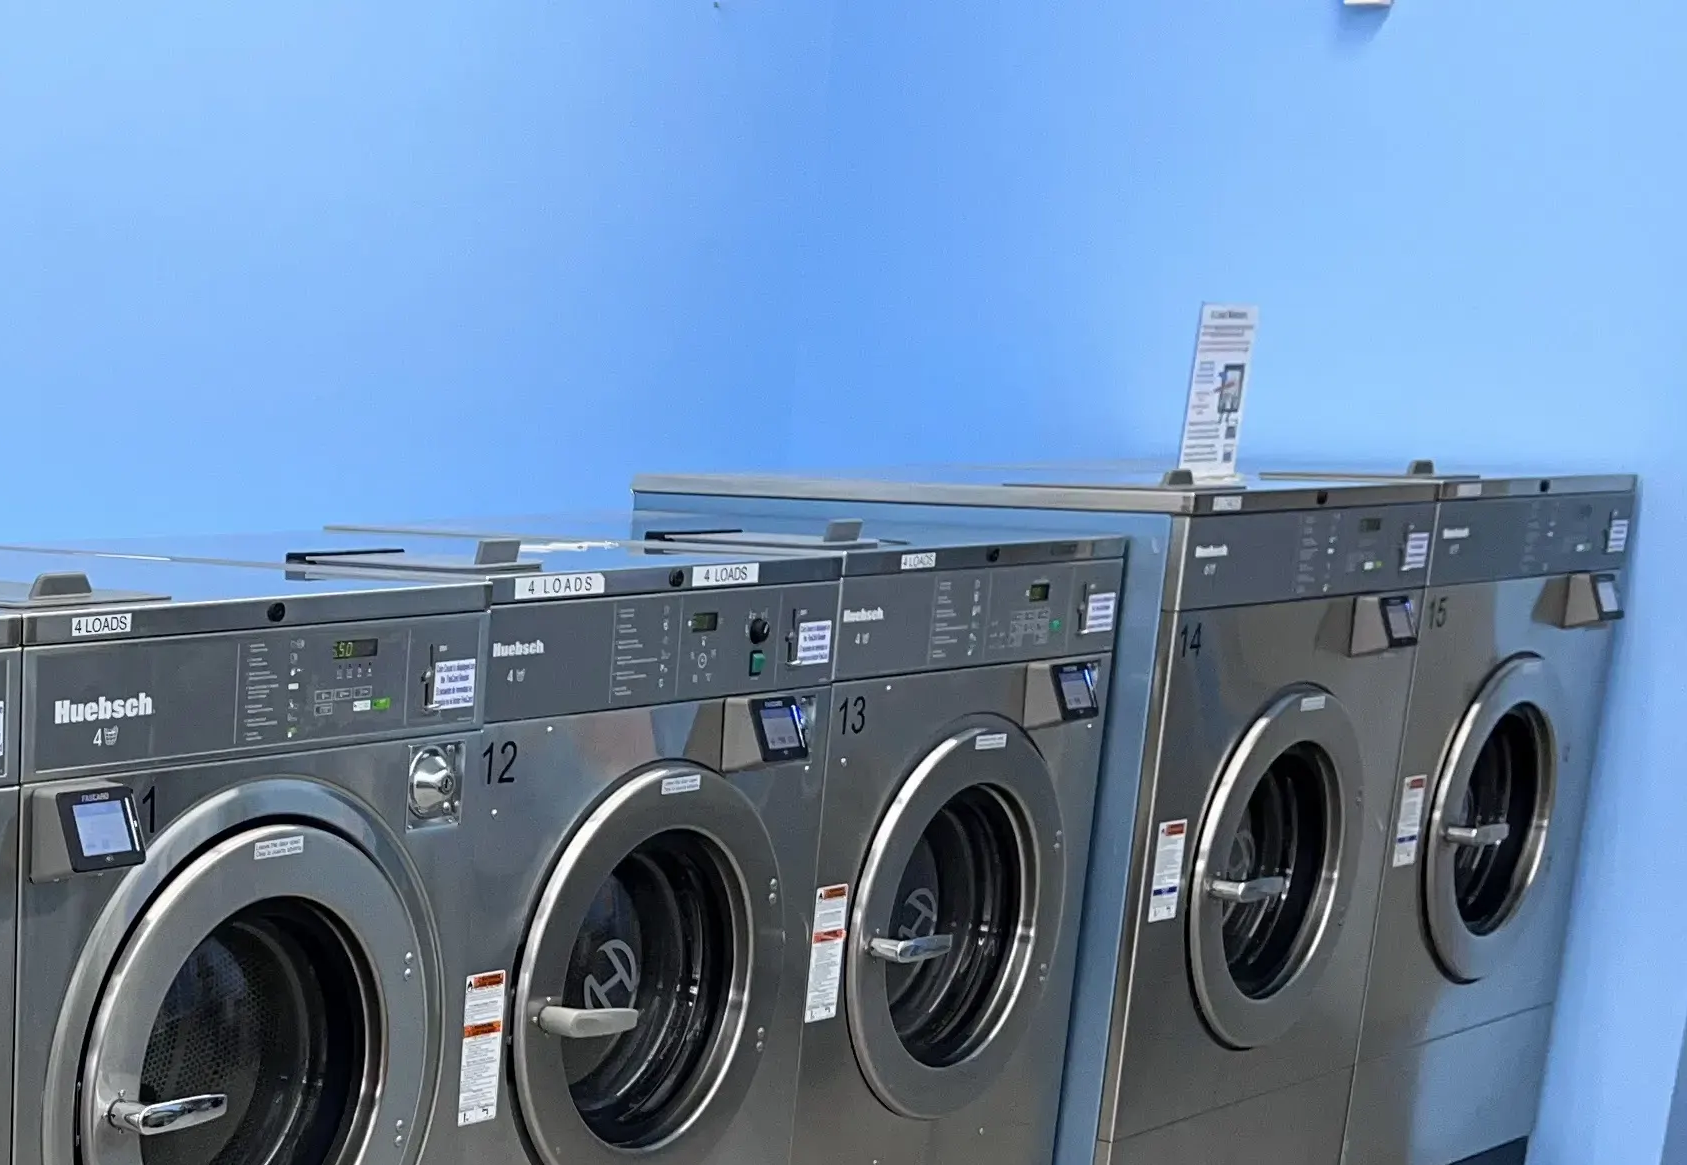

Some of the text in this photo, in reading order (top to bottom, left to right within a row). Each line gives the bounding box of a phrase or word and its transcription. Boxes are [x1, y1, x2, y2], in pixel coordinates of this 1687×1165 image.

[704, 567, 747, 582] 4 LOADS
[528, 576, 593, 594] 4 LOADS
[1429, 596, 1448, 629] 15
[75, 616, 127, 633] 4 LOADS
[493, 640, 544, 657] Huebsch
[1181, 623, 1202, 657] 14
[507, 669, 513, 682] 4
[55, 692, 152, 724] Huebsch
[839, 696, 865, 735] 13
[93, 728, 102, 746] 4
[483, 741, 517, 784] 12
